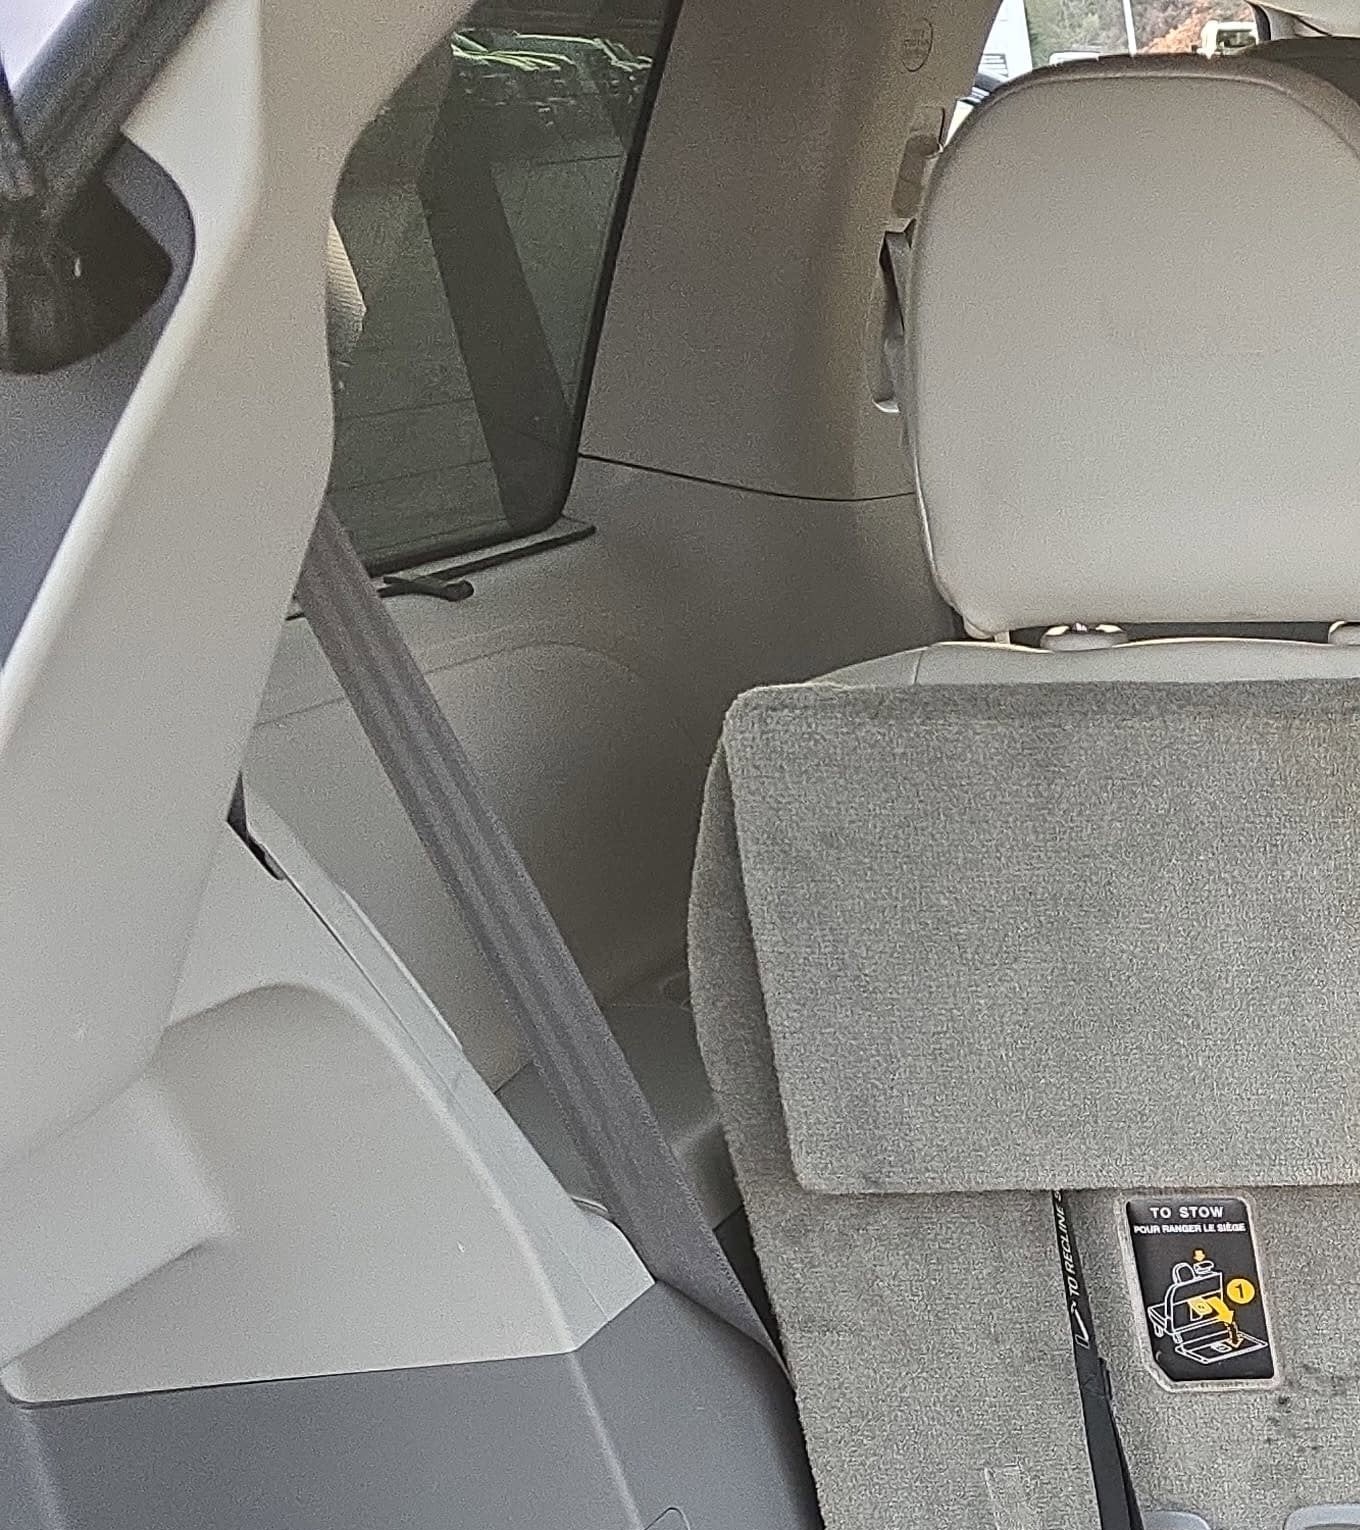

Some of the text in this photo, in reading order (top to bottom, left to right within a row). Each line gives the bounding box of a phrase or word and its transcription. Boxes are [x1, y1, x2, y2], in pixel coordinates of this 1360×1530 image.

[1150, 1206, 1224, 1218] TO STOW
[1134, 1224, 1160, 1234] POUR
[1162, 1224, 1202, 1233] RANGER
[1203, 1224, 1216, 1232] LE
[1056, 1206, 1076, 1274] RECLINE
[1067, 1276, 1080, 1296] TO
[1234, 1283, 1244, 1298] 1
